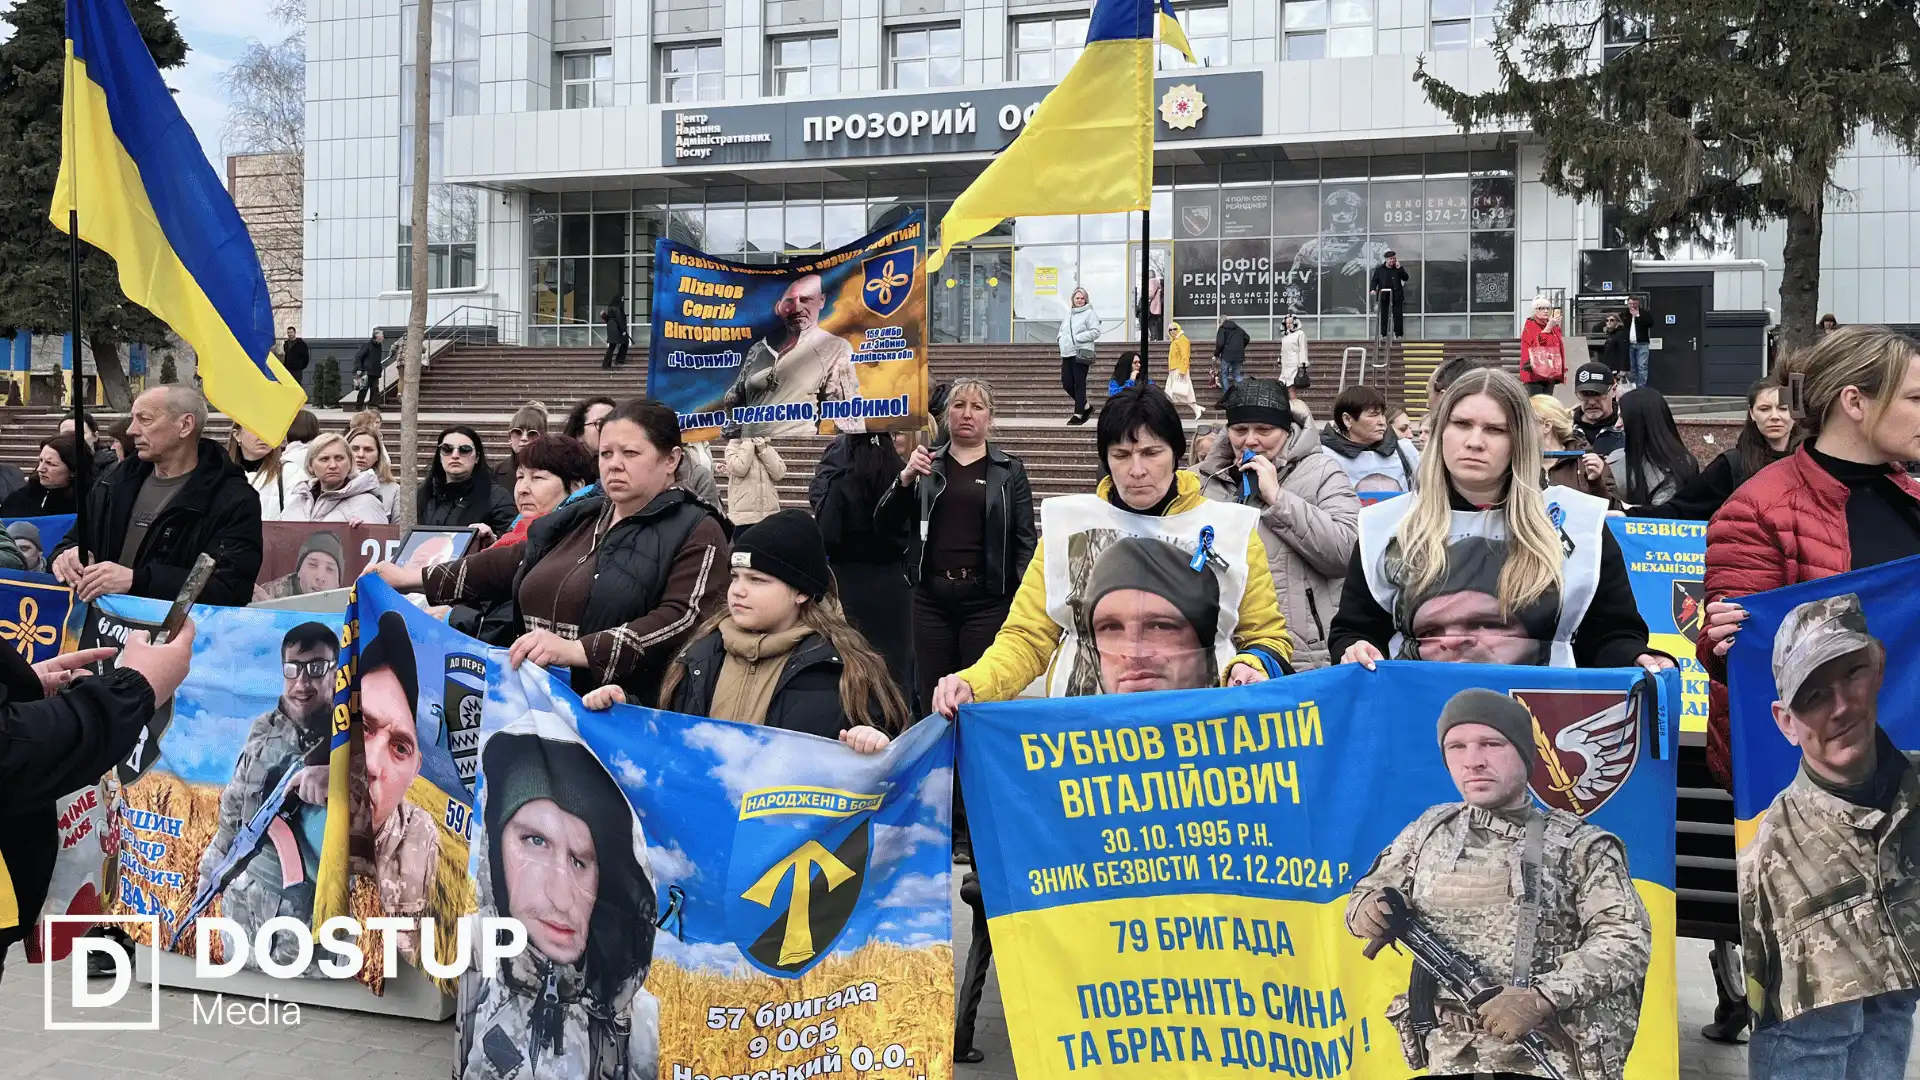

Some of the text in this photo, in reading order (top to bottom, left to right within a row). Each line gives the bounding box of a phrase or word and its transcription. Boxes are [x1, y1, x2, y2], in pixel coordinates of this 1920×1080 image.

[675, 113, 709, 124] Центр
[675, 123, 722, 136] Надання
[803, 102, 977, 142] ПРОЗОРИЙ
[675, 133, 772, 147] Адміністративних
[675, 146, 713, 158] Послуг
[1221, 257, 1270, 272] ОФІС
[678, 276, 744, 299] Ліхачов
[682, 299, 737, 320] Сергій
[664, 320, 753, 342] Вікторович
[668, 350, 742, 369] «Чорний»
[733, 400, 818, 424] чекаємо,
[821, 395, 908, 419] любимо!
[1021, 701, 1324, 772] БУБНОВ ВІТАЛІЙ
[747, 793, 834, 811] НАРОДЖЕНІ
[837, 798, 847, 810] В
[1058, 761, 1301, 819] ВІТАЛІЙОВИЧ
[1101, 820, 1273, 854] 30.10.1995 Р.Н.
[1028, 865, 1090, 896] ЗНИК
[1093, 854, 1200, 888] БЕЗВІСТИ
[1207, 853, 1334, 890] 12.12.2024
[1109, 916, 1295, 957] 79 БРИГАДА
[706, 981, 878, 1030] 57 бригада
[1077, 977, 1348, 1029] ПОВЕРНІТЬ СИНА
[748, 1017, 838, 1059] 9 ОСБ
[1057, 1030, 1101, 1071] ТА
[1106, 1025, 1213, 1065] БРАТА
[850, 1043, 915, 1072] О.О.
